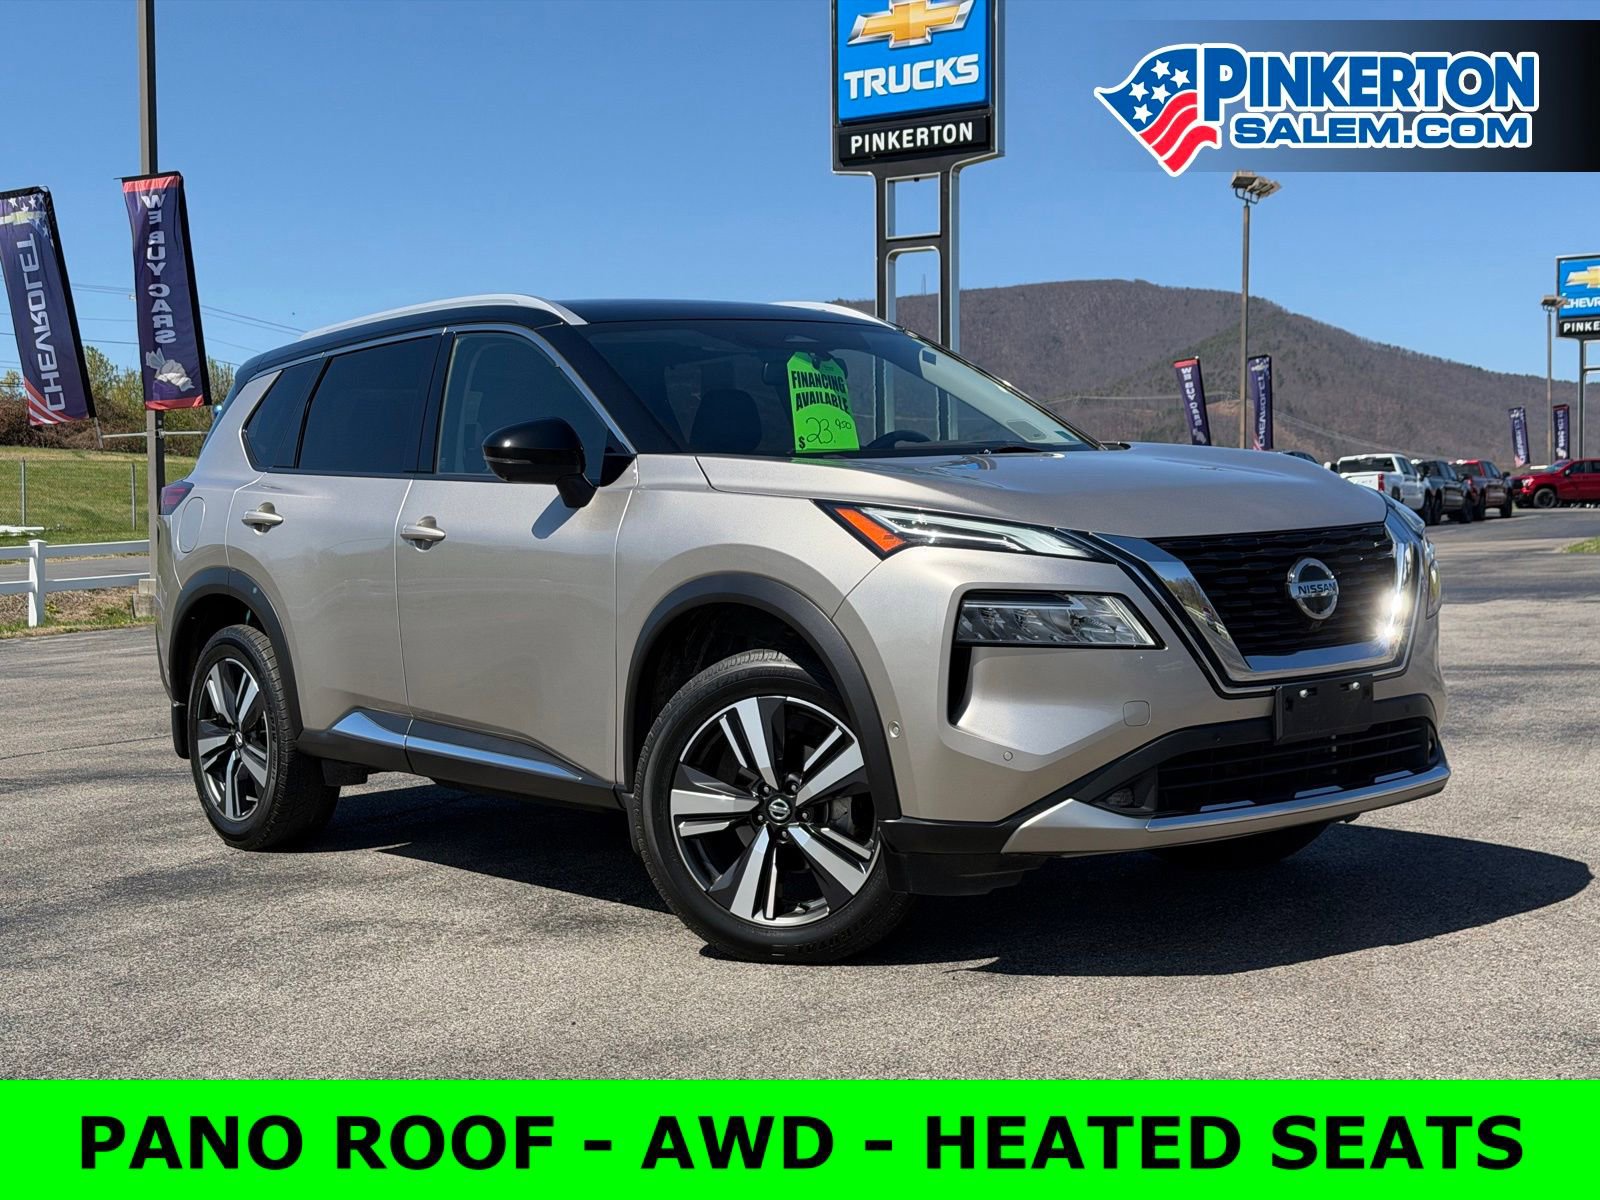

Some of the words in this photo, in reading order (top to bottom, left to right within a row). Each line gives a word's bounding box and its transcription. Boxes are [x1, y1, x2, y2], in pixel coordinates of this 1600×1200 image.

[843, 53, 980, 100] TRUCKS
[850, 121, 973, 154] PINKERTON
[791, 370, 847, 394] FINANCING
[795, 391, 850, 415] AVAILABLE
[1297, 582, 1336, 595] NISSAN
